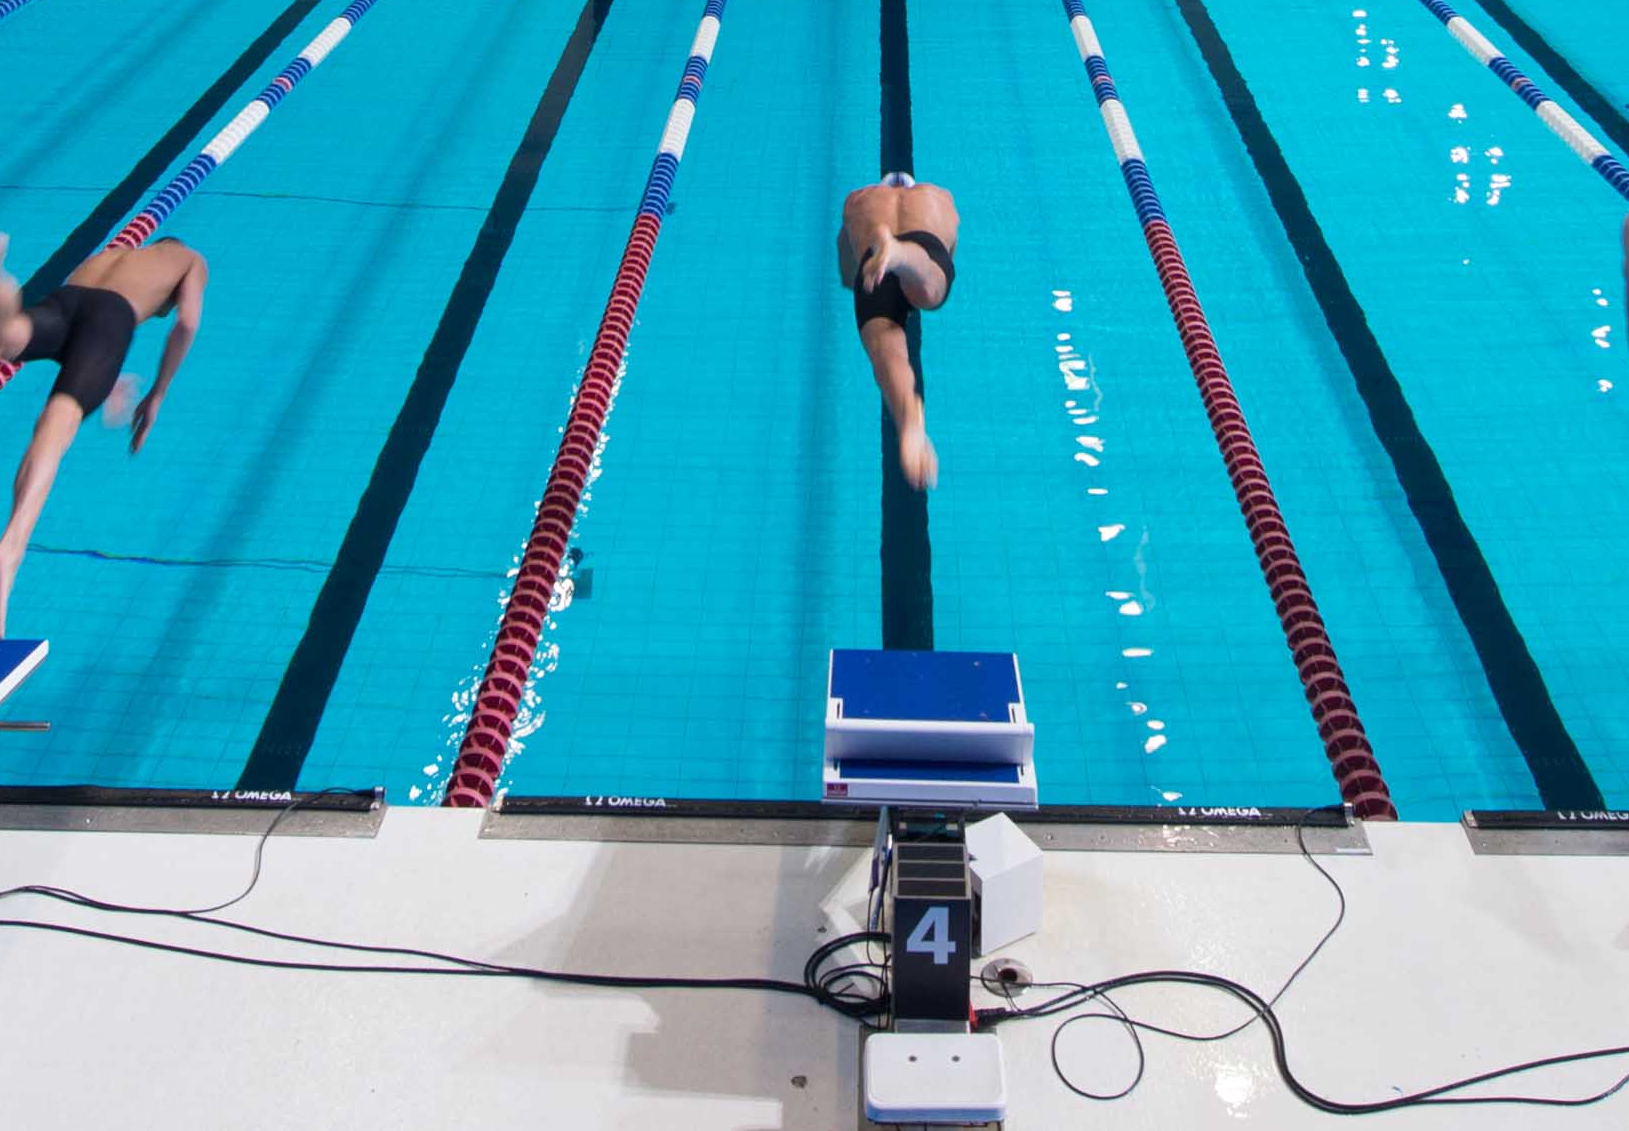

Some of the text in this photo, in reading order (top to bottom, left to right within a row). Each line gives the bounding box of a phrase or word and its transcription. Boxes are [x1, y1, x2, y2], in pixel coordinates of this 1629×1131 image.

[235, 790, 293, 801] OMEGA
[608, 796, 667, 807] OMEGA
[1200, 806, 1261, 817] OMEGA
[906, 906, 956, 965] 4
